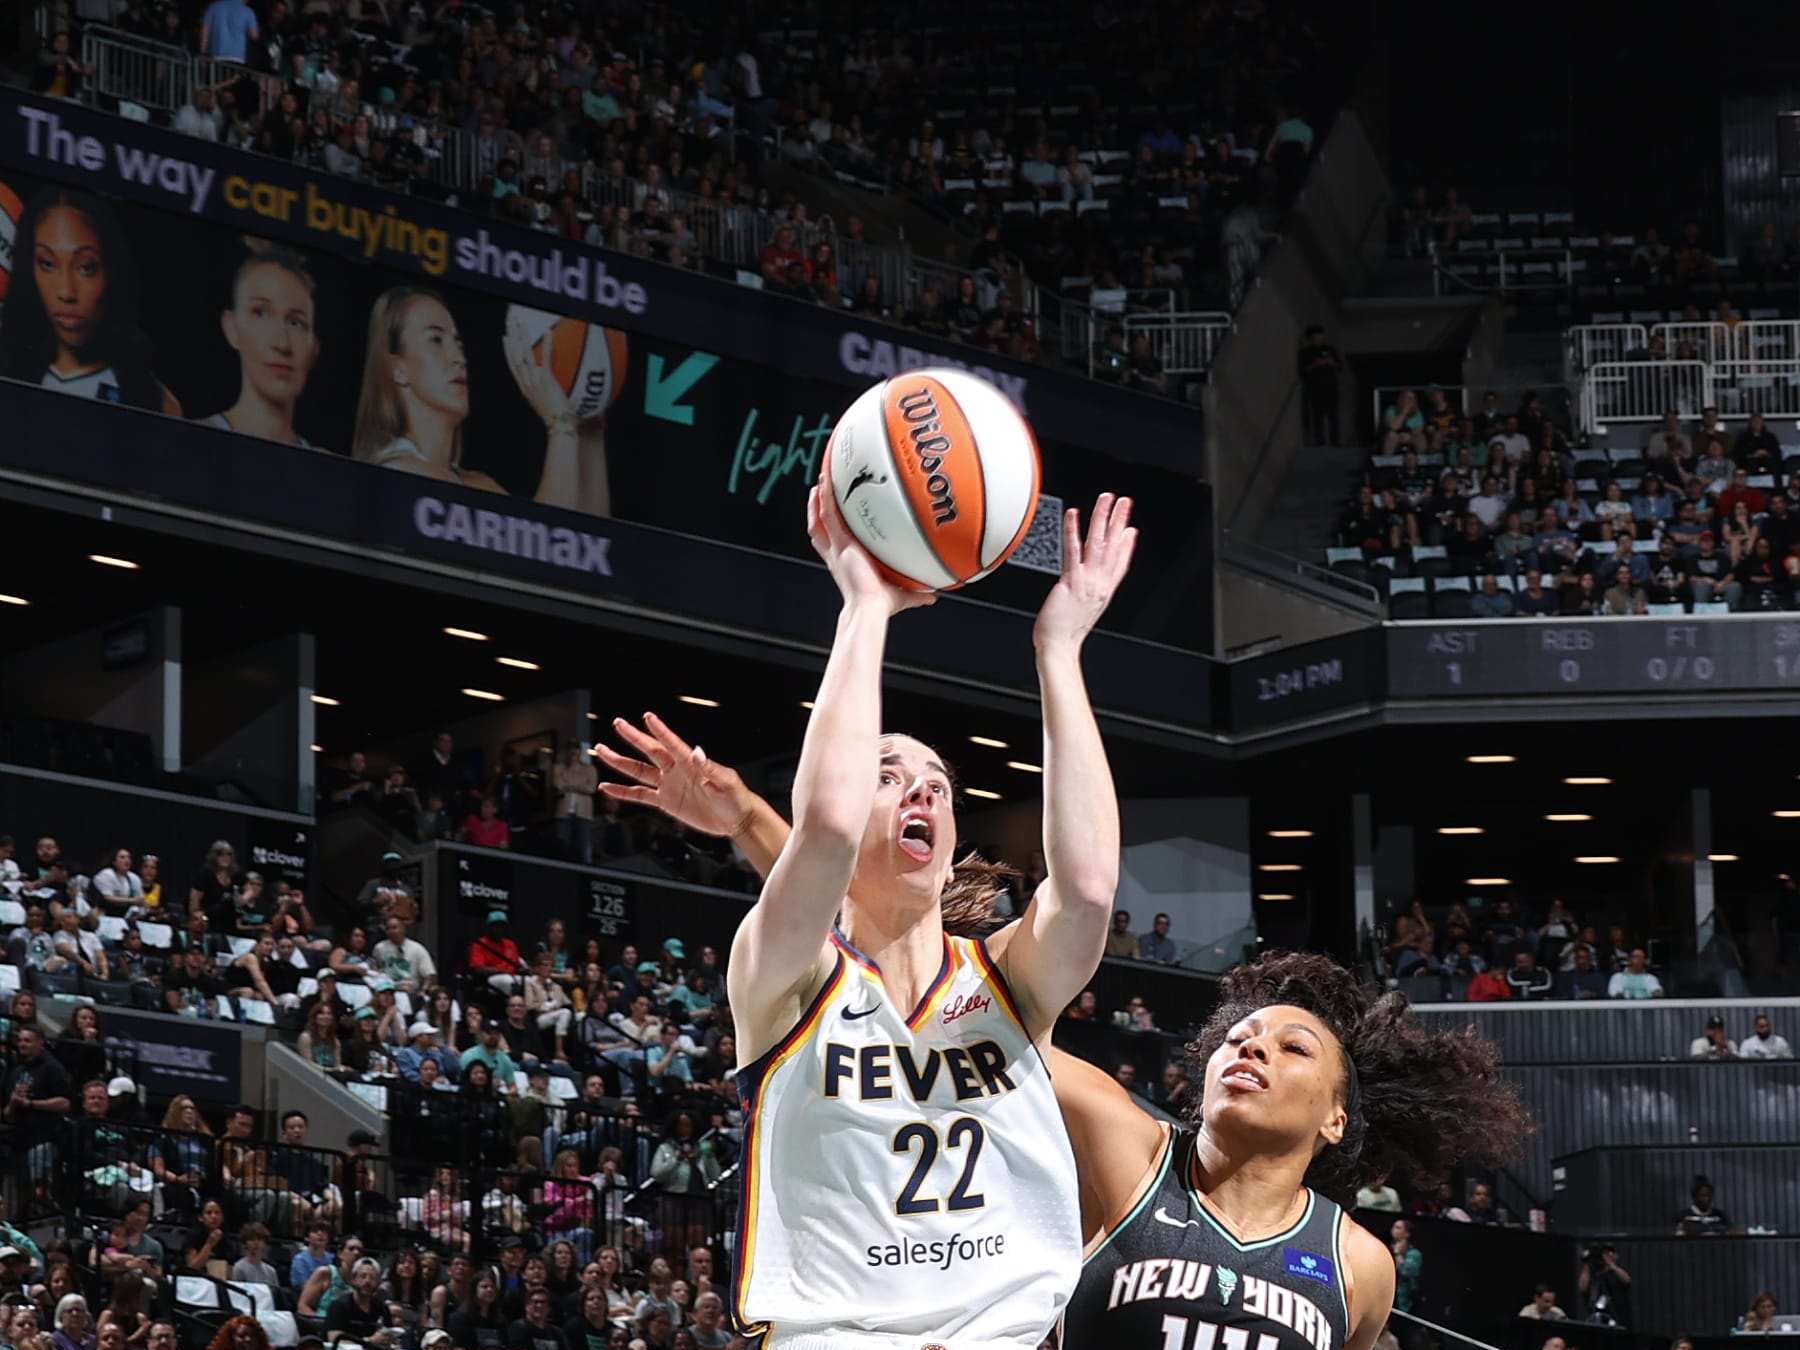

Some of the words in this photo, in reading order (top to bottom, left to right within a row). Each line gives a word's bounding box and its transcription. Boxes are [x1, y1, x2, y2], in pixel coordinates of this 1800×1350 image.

[17, 105, 105, 172] The
[113, 144, 216, 214] way
[223, 175, 298, 222] car
[307, 185, 449, 276] buying
[456, 229, 589, 301] should
[595, 262, 648, 315] be
[728, 408, 832, 505] light
[896, 388, 958, 527] Wilson
[1427, 630, 1479, 653] AST
[1541, 628, 1595, 651] REB
[1666, 626, 1699, 649] FT
[1306, 658, 1343, 688] PM
[1446, 661, 1462, 685] 1
[1560, 658, 1580, 682] 0
[473, 883, 510, 901] clover
[592, 893, 625, 917] 126
[943, 994, 991, 1025] Lilly
[823, 1040, 1016, 1103] FEVER
[893, 1115, 985, 1217] 22
[866, 1233, 1004, 1270] salesforce
[1107, 1258, 1213, 1311] NEW
[1289, 1264, 1329, 1282] BARCLAYS
